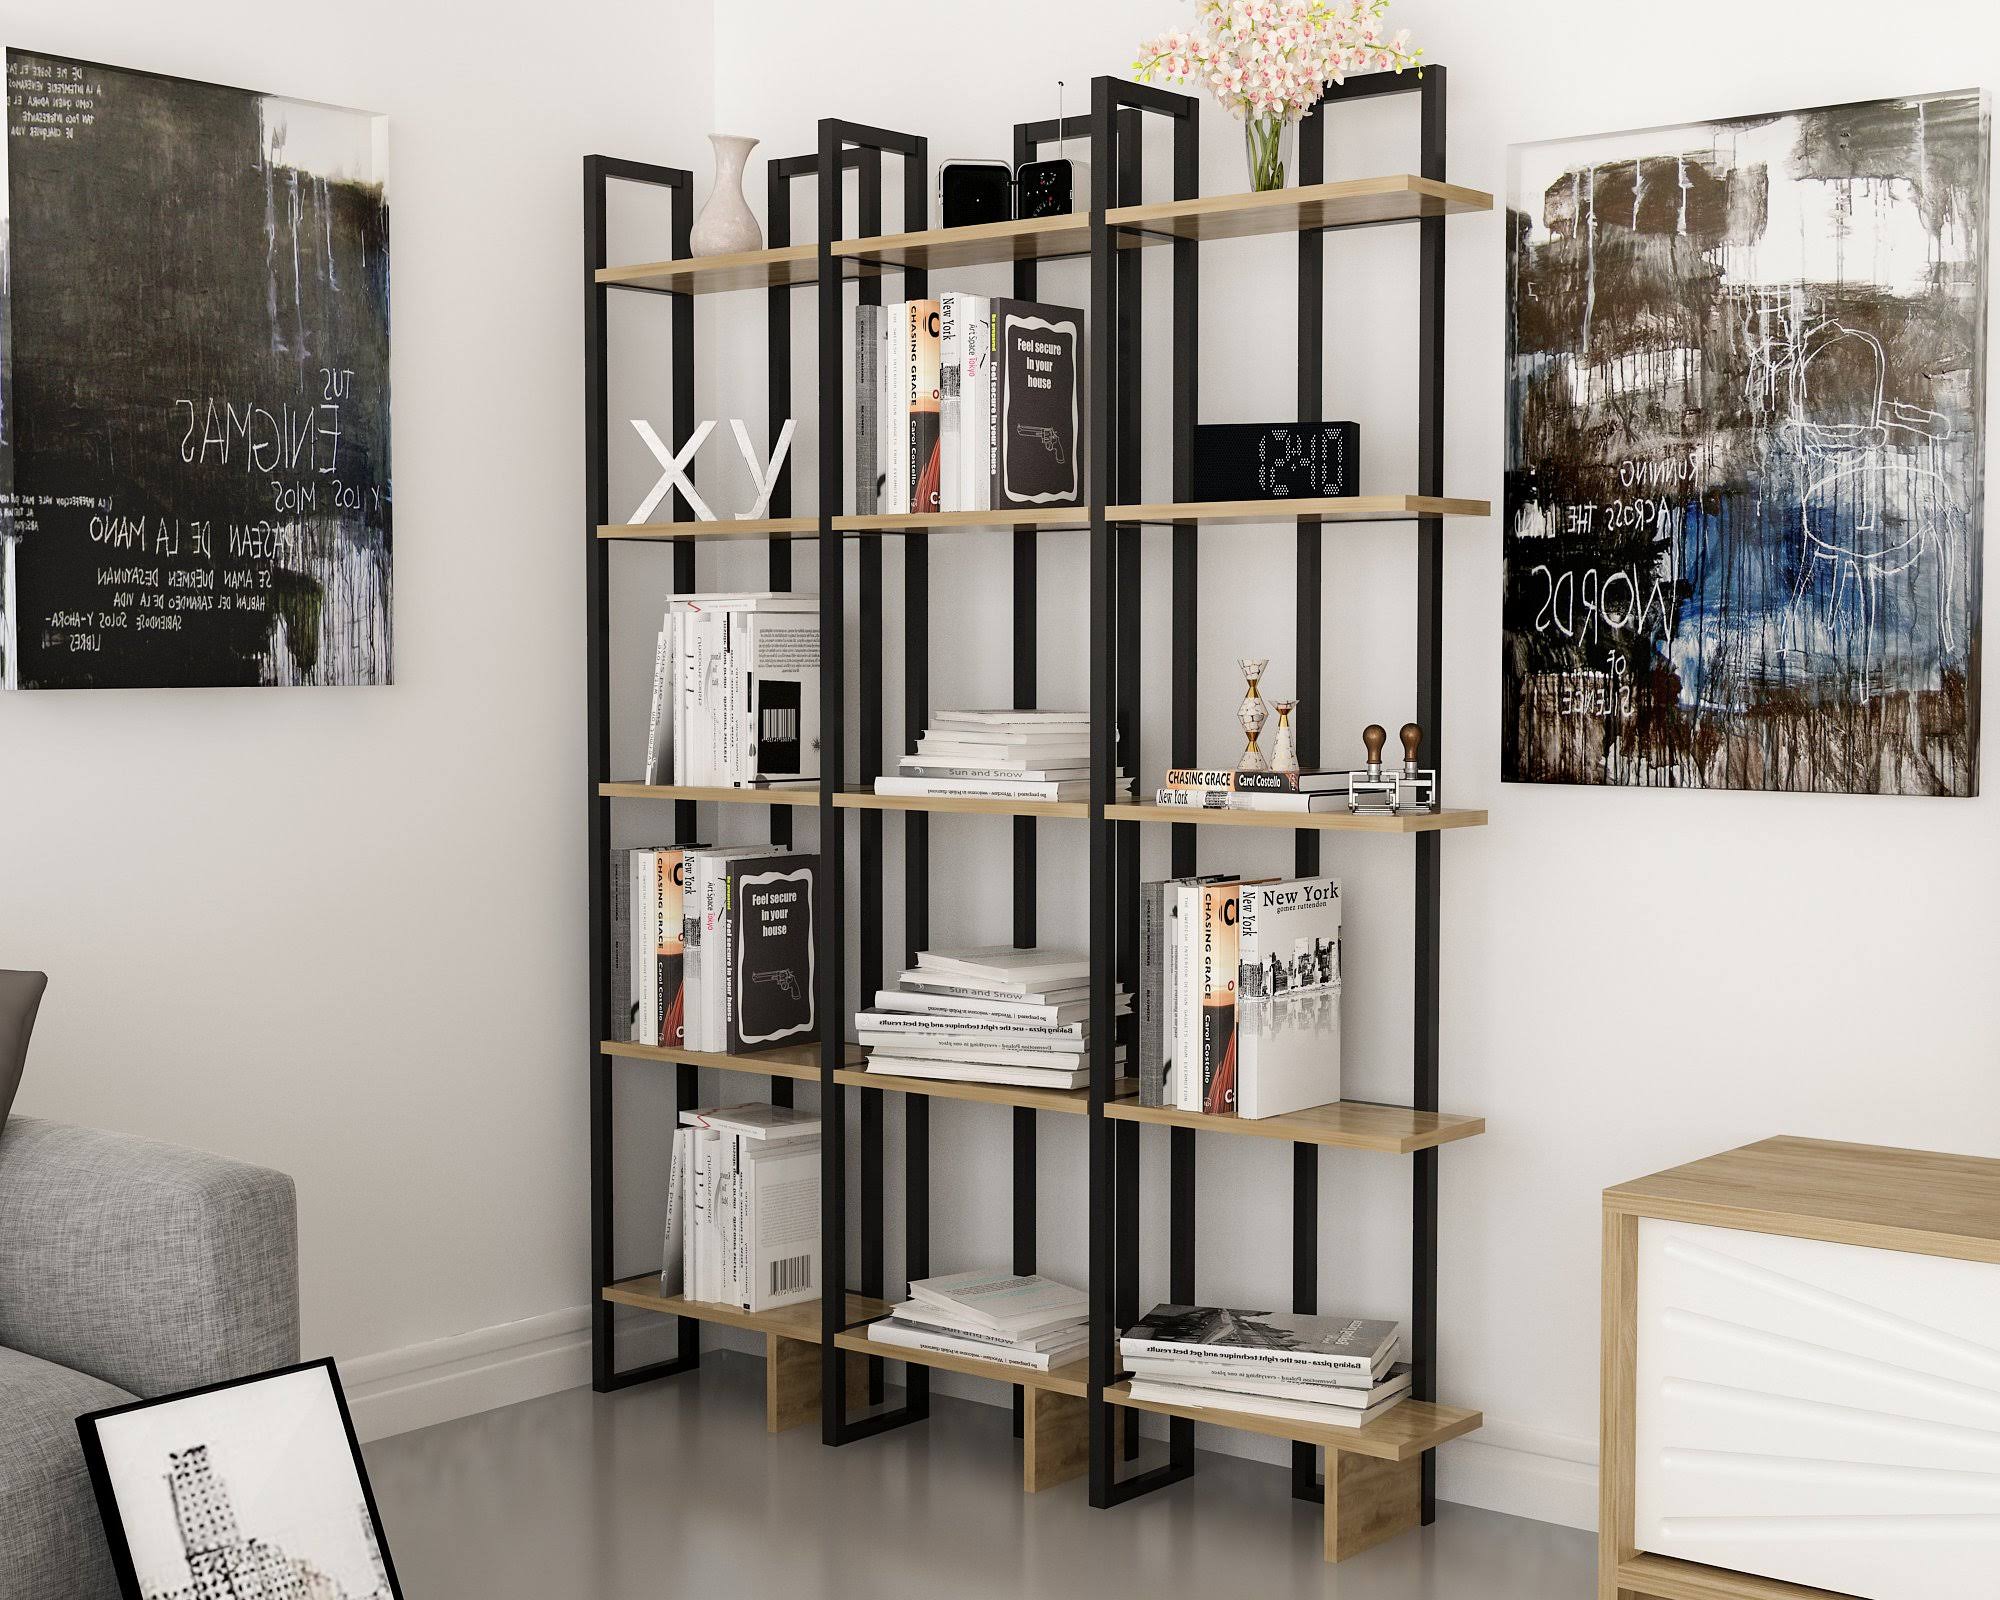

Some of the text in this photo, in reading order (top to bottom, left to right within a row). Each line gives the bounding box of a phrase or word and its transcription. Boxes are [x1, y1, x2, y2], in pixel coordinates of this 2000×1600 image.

[942, 298, 956, 341] New York
[968, 334, 976, 356] Space
[1017, 338, 1061, 356] Feel secure
[968, 357, 976, 377] Tokyo
[1026, 358, 1052, 373] in your
[1028, 376, 1052, 390] house
[1259, 428, 1343, 495] 12:40
[994, 770, 1022, 778] Snow
[1168, 770, 1230, 786] CHASING GRACE
[1239, 774, 1280, 788] Carol Costello
[1158, 790, 1188, 804] New York
[685, 856, 696, 895] New York
[752, 892, 797, 906] Feel secure
[1263, 881, 1339, 907] New York
[762, 908, 788, 922] in your
[1243, 892, 1257, 937] New York
[762, 925, 787, 937] house
[971, 989, 990, 997] and
[994, 991, 1022, 1000] Snow
